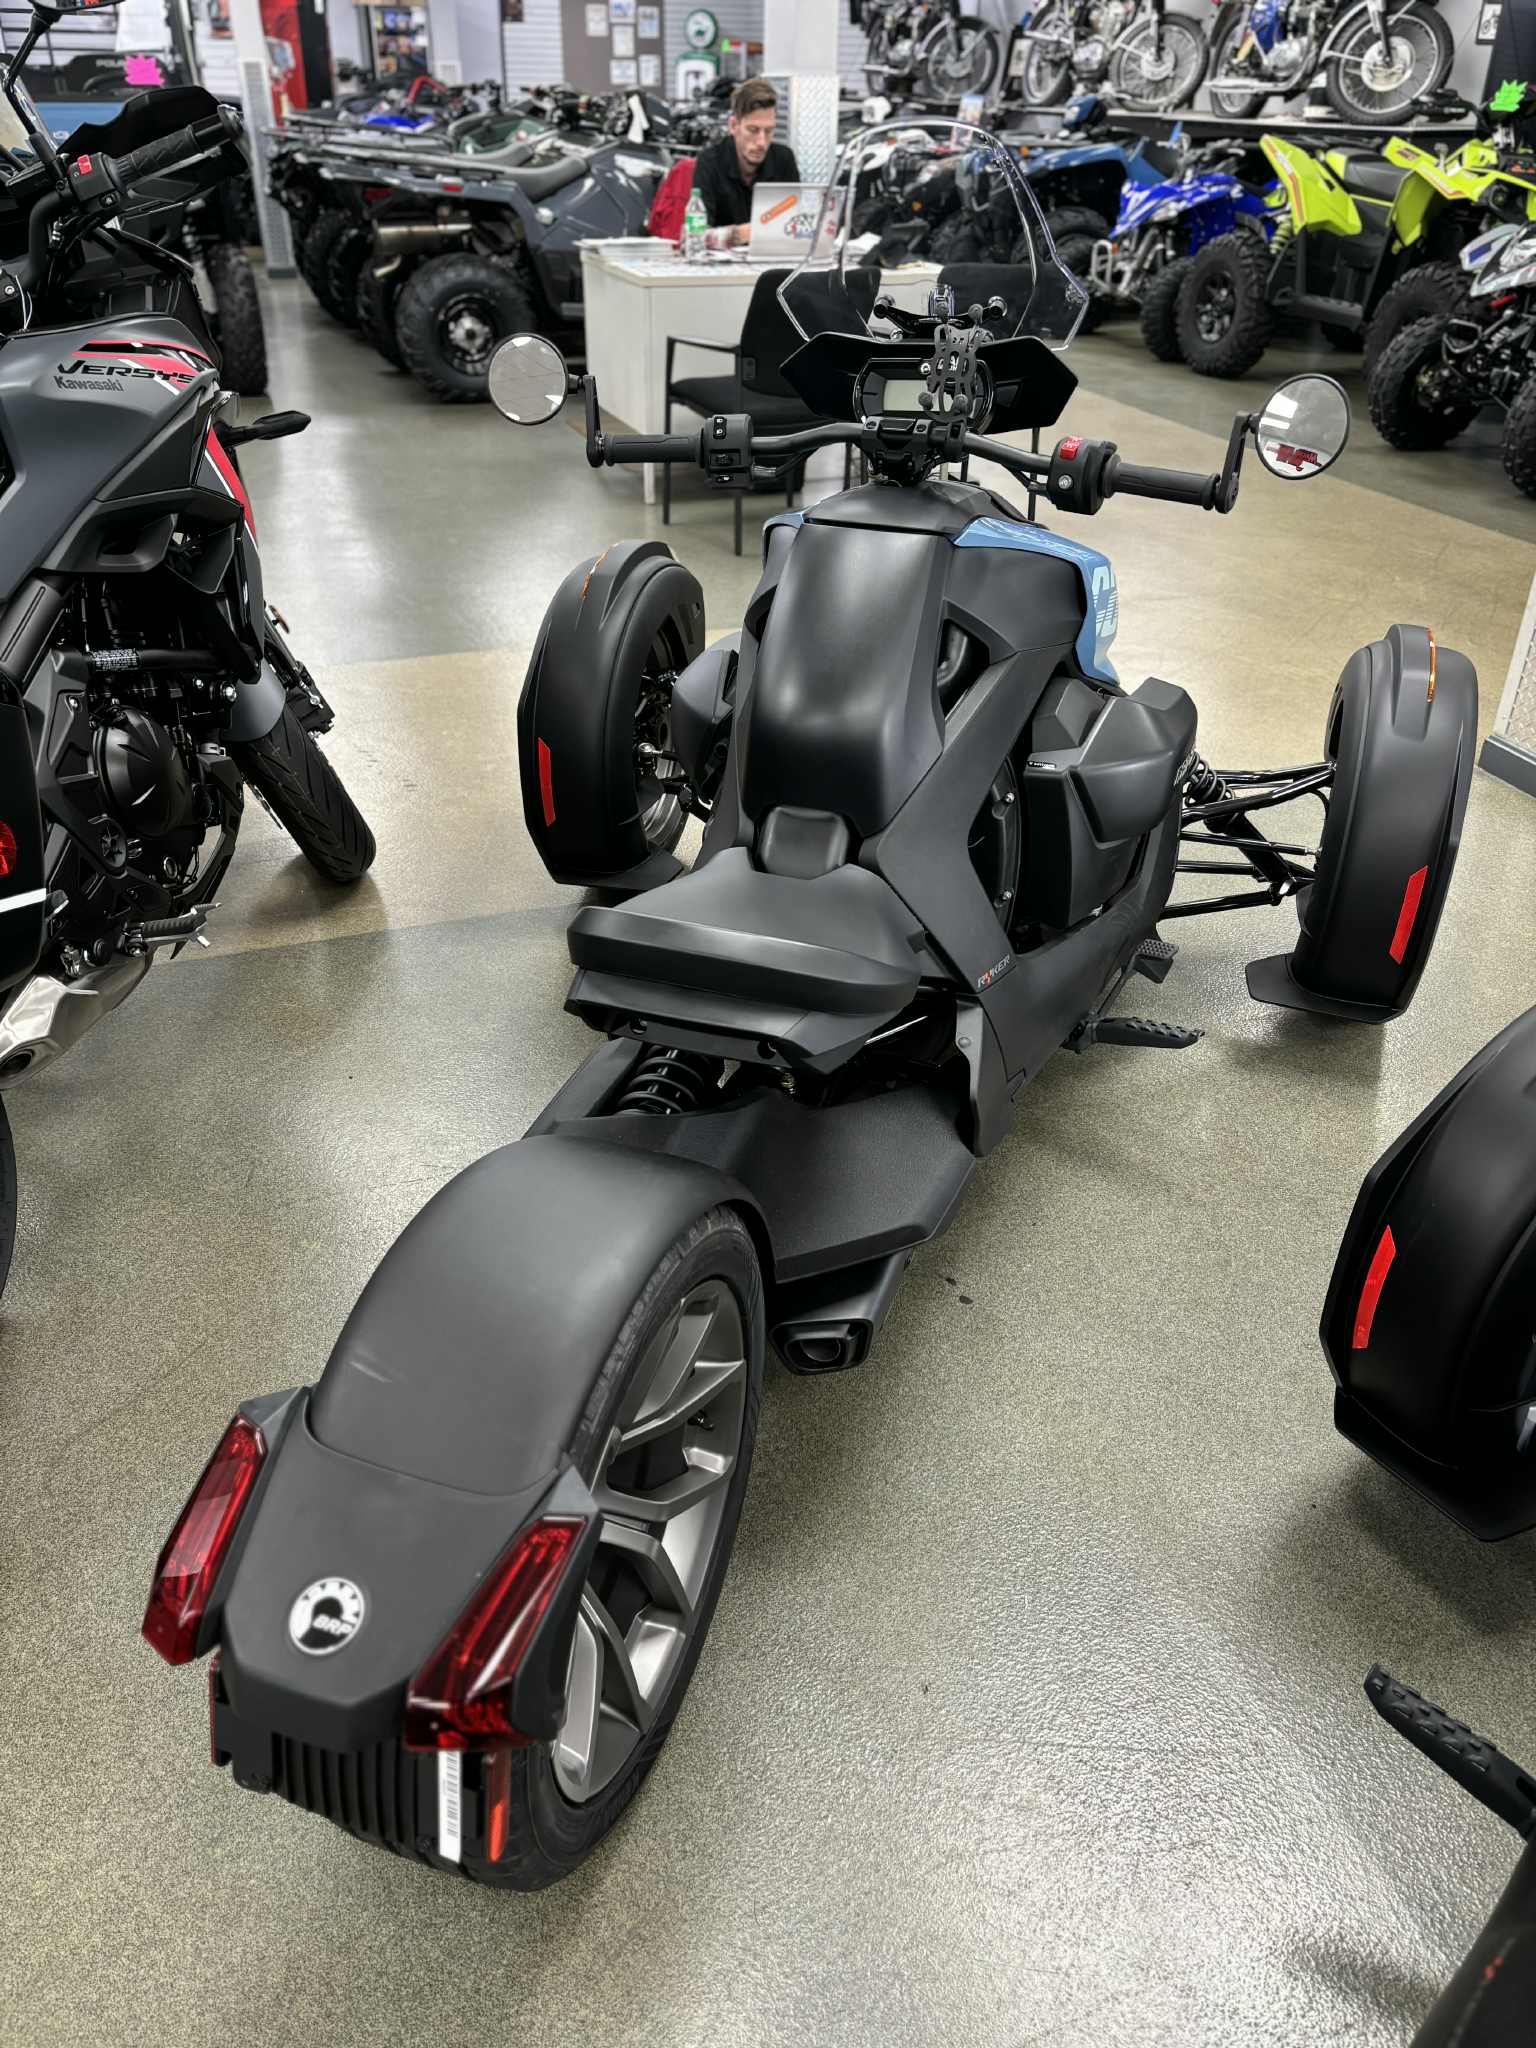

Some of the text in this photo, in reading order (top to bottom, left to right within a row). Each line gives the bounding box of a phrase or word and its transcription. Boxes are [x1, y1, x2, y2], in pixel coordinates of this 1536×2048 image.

[54, 375, 125, 392] Kawasaki
[57, 360, 196, 384] VERSYS
[977, 954, 1011, 988] RYKER
[312, 1613, 353, 1636] BRP
